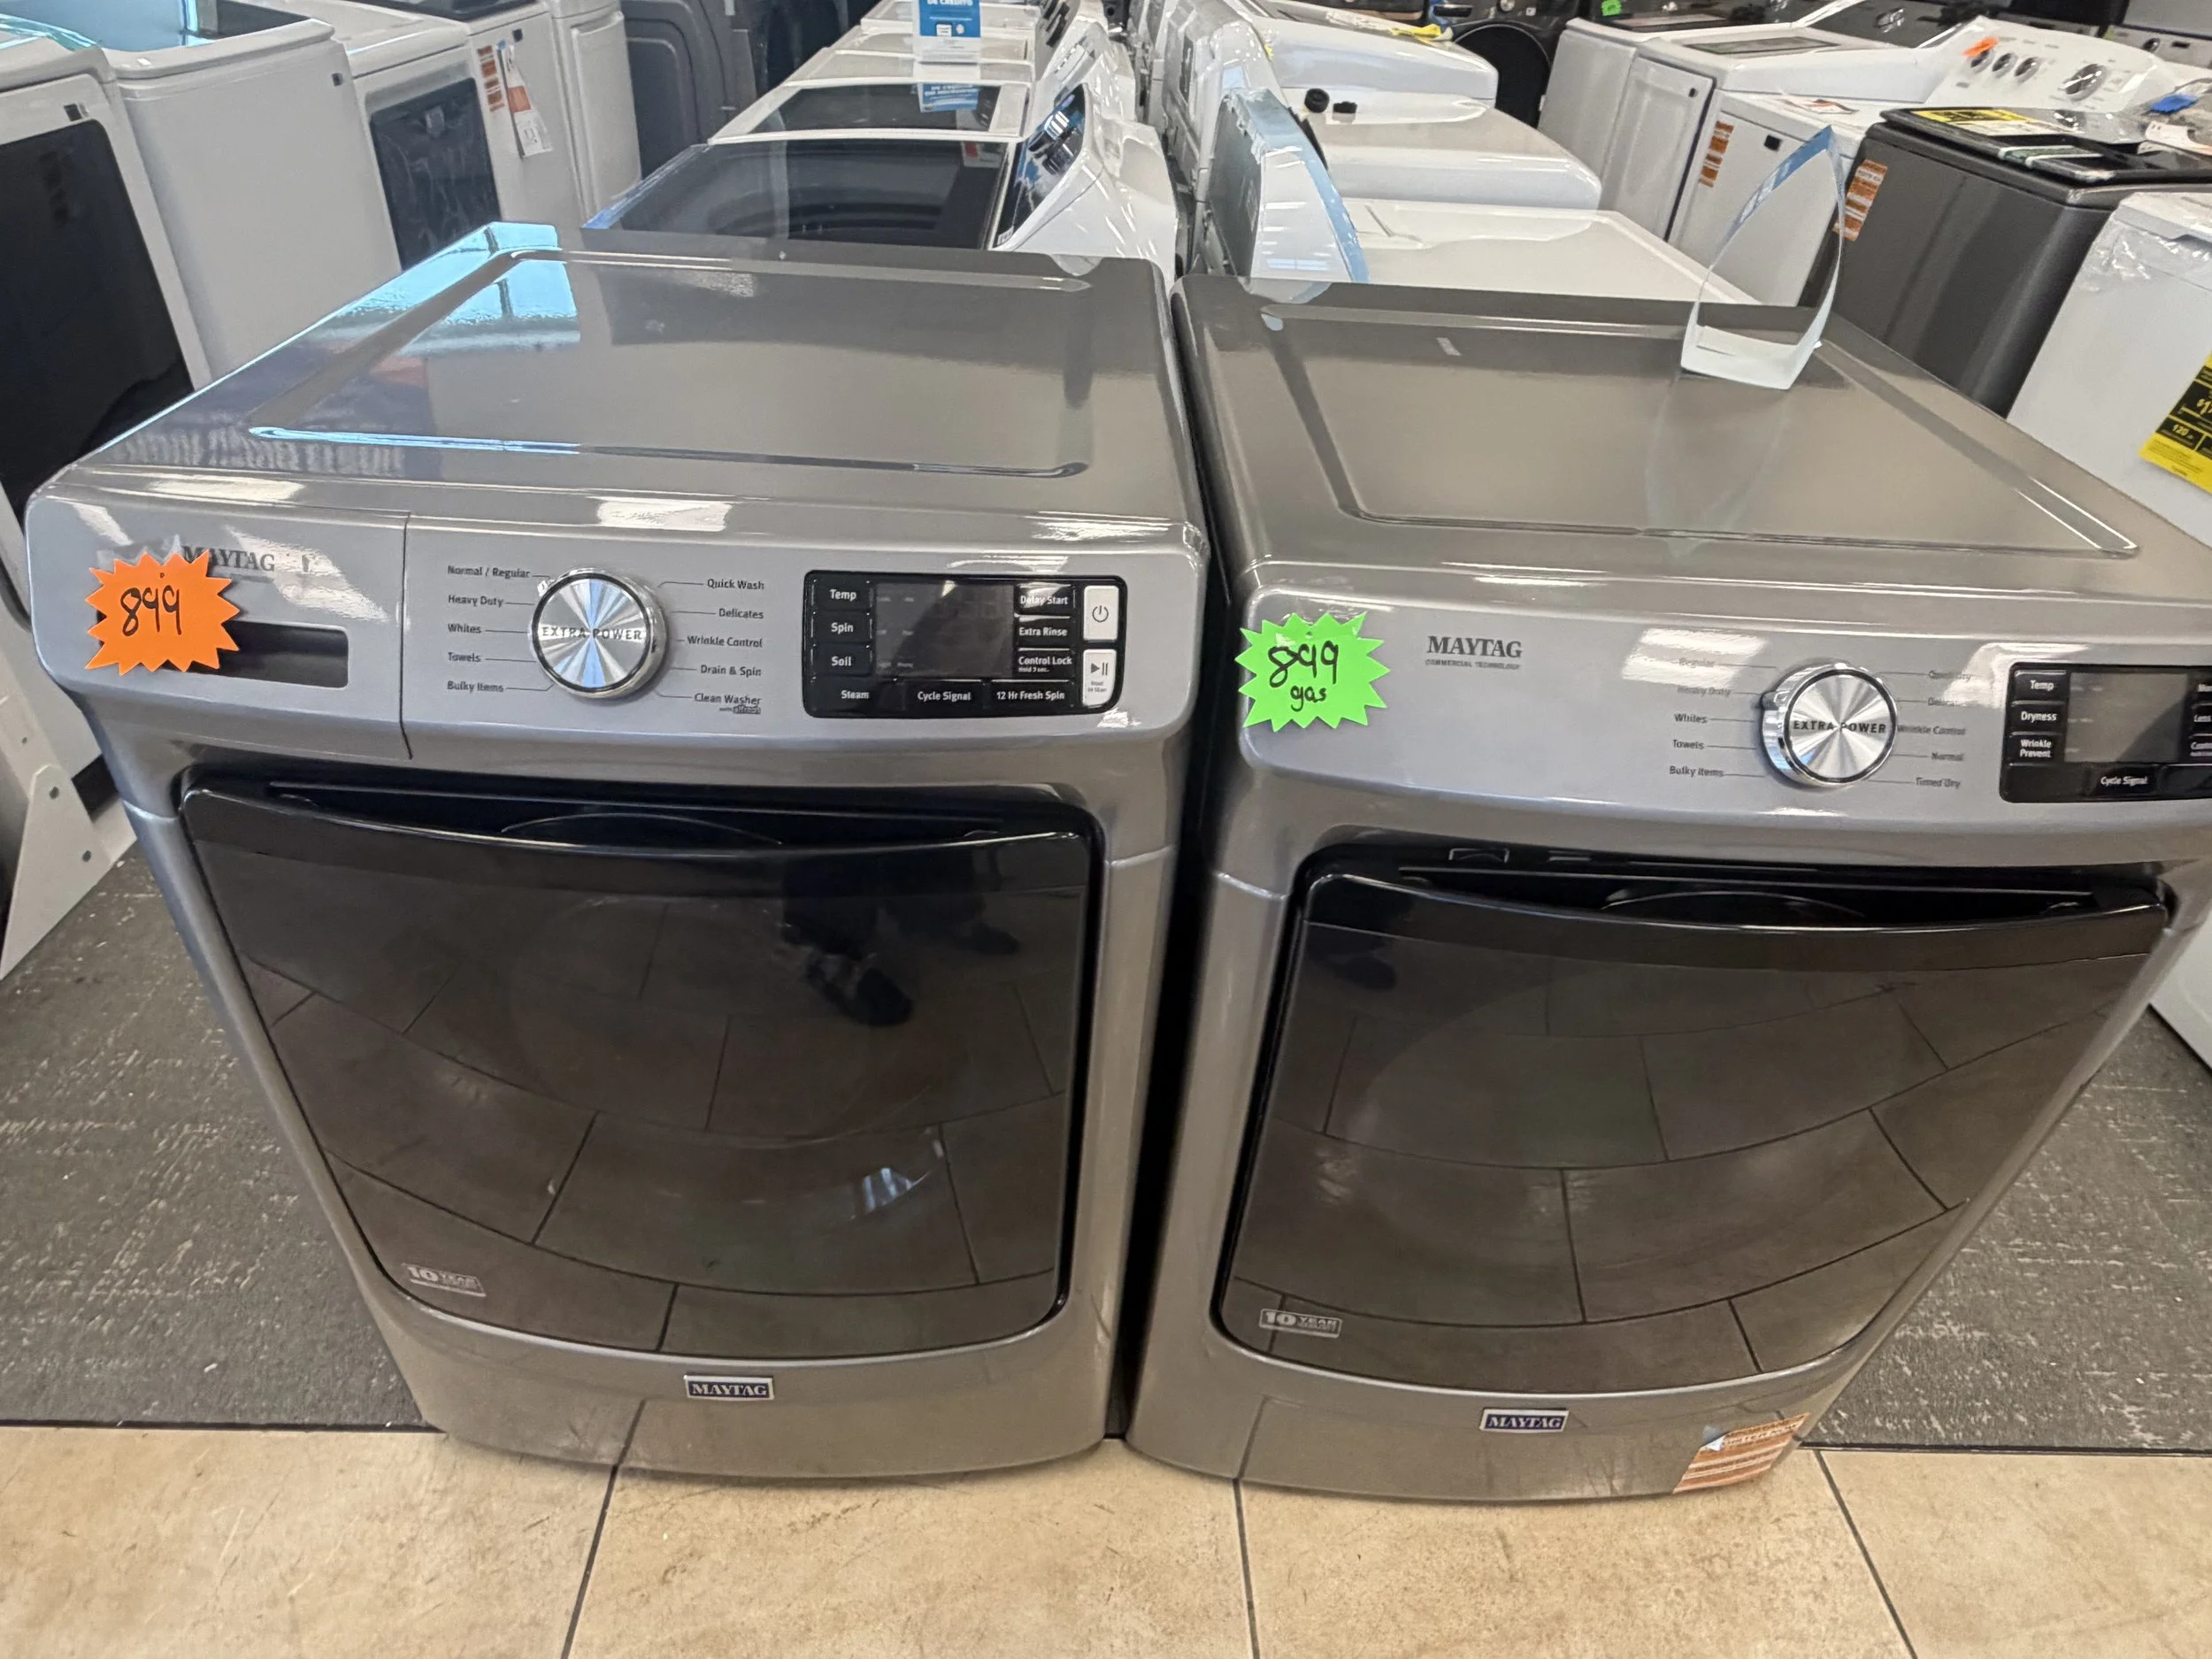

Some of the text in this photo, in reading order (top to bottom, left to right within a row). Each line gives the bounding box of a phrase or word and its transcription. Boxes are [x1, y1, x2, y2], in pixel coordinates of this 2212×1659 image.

[447, 565, 482, 576] Normal
[492, 567, 531, 580] Regular
[707, 579, 764, 590] Quick Wash
[830, 588, 857, 602] Temp
[1047, 595, 1068, 605] Start
[448, 595, 504, 608] Heavy Duty
[120, 585, 182, 636] 899
[718, 608, 764, 619] Delicates
[447, 623, 482, 634] Whites
[541, 626, 641, 640] EXTRA POWER
[831, 622, 854, 634] Spin
[1018, 627, 1068, 636] Extra Rinse
[687, 635, 763, 648] Wrinkle Control
[1426, 635, 1523, 658] MAYTAG
[447, 652, 482, 663] Towels
[831, 656, 852, 666] Soil
[1018, 657, 1072, 665] Control Lock
[1268, 640, 1340, 687] 899
[700, 664, 762, 678] Drain & Spin
[447, 680, 504, 694] Bulky Items
[2030, 680, 2055, 691] Temp
[694, 693, 762, 705] Clean Washer
[841, 690, 870, 699] Steam
[917, 691, 971, 703] Cycle Signal
[996, 690, 1065, 701] 12 Hr Fresh Spin
[1289, 685, 1328, 712] gas
[1673, 713, 1709, 724] Whites
[2020, 710, 2058, 723] Dryness
[1793, 720, 1886, 733] EXTRA POWER
[1672, 739, 1705, 750] Towels
[2020, 739, 2052, 749] Wrinkle
[2019, 749, 2052, 758] Prevent
[1669, 765, 1724, 778] Bulky Items
[2100, 775, 2148, 787] Cycle Signal
[407, 1266, 439, 1282] 10
[1265, 1311, 1297, 1325] 10
[692, 1383, 767, 1396] MAYTAG
[1487, 1416, 1562, 1428] MAYTAG
